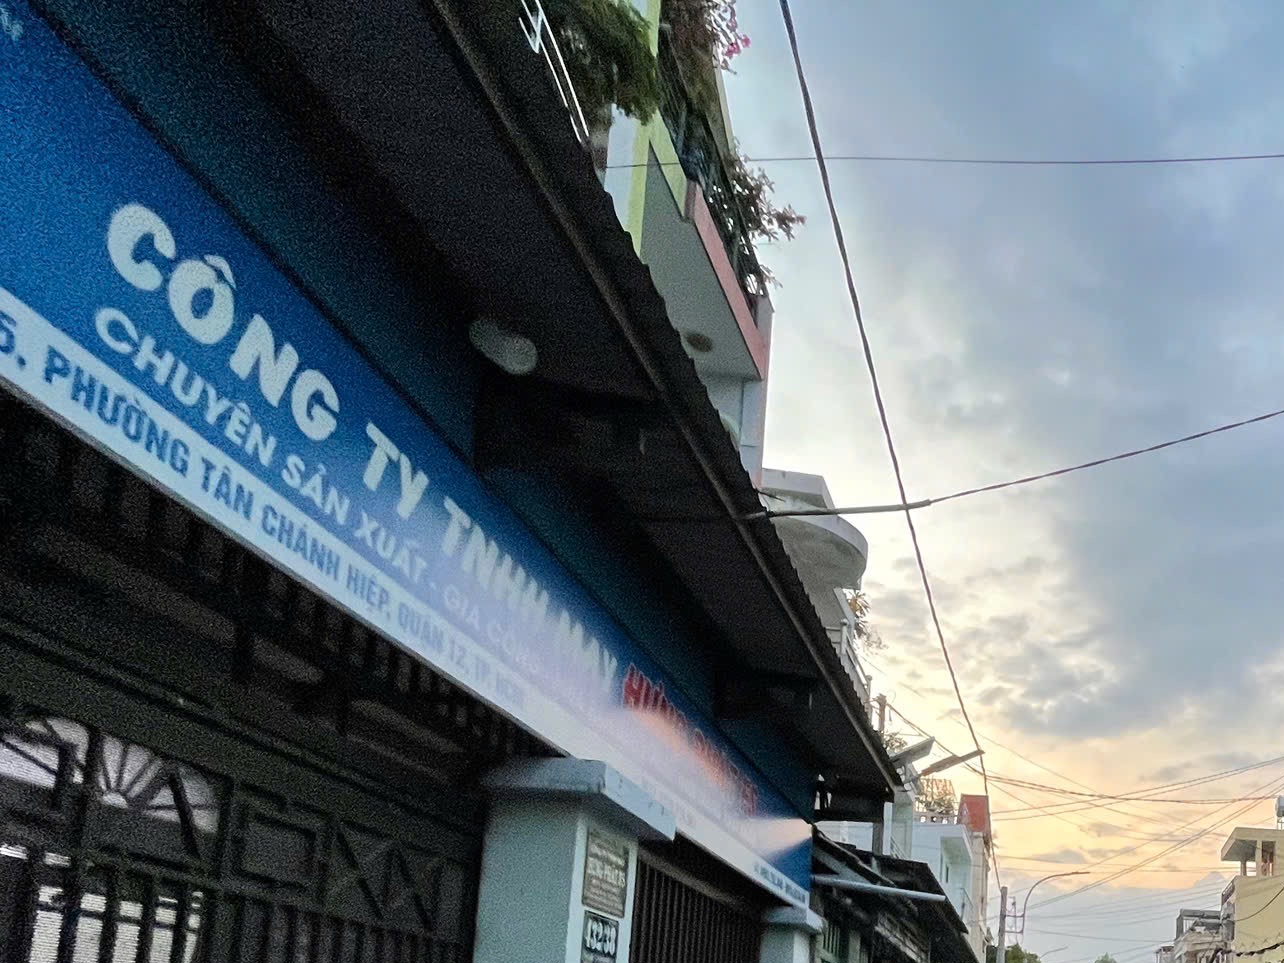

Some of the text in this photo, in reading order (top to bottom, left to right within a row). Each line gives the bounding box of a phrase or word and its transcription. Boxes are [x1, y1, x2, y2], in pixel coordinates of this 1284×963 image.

[44, 344, 191, 478] PHƯỜNG
[201, 456, 255, 521] TÂN
[261, 503, 340, 581] CHÁNH
[95, 307, 276, 467] CHUYÊN
[281, 455, 350, 525] SẢN
[107, 203, 340, 441] CÔNG
[362, 420, 430, 519] TY
